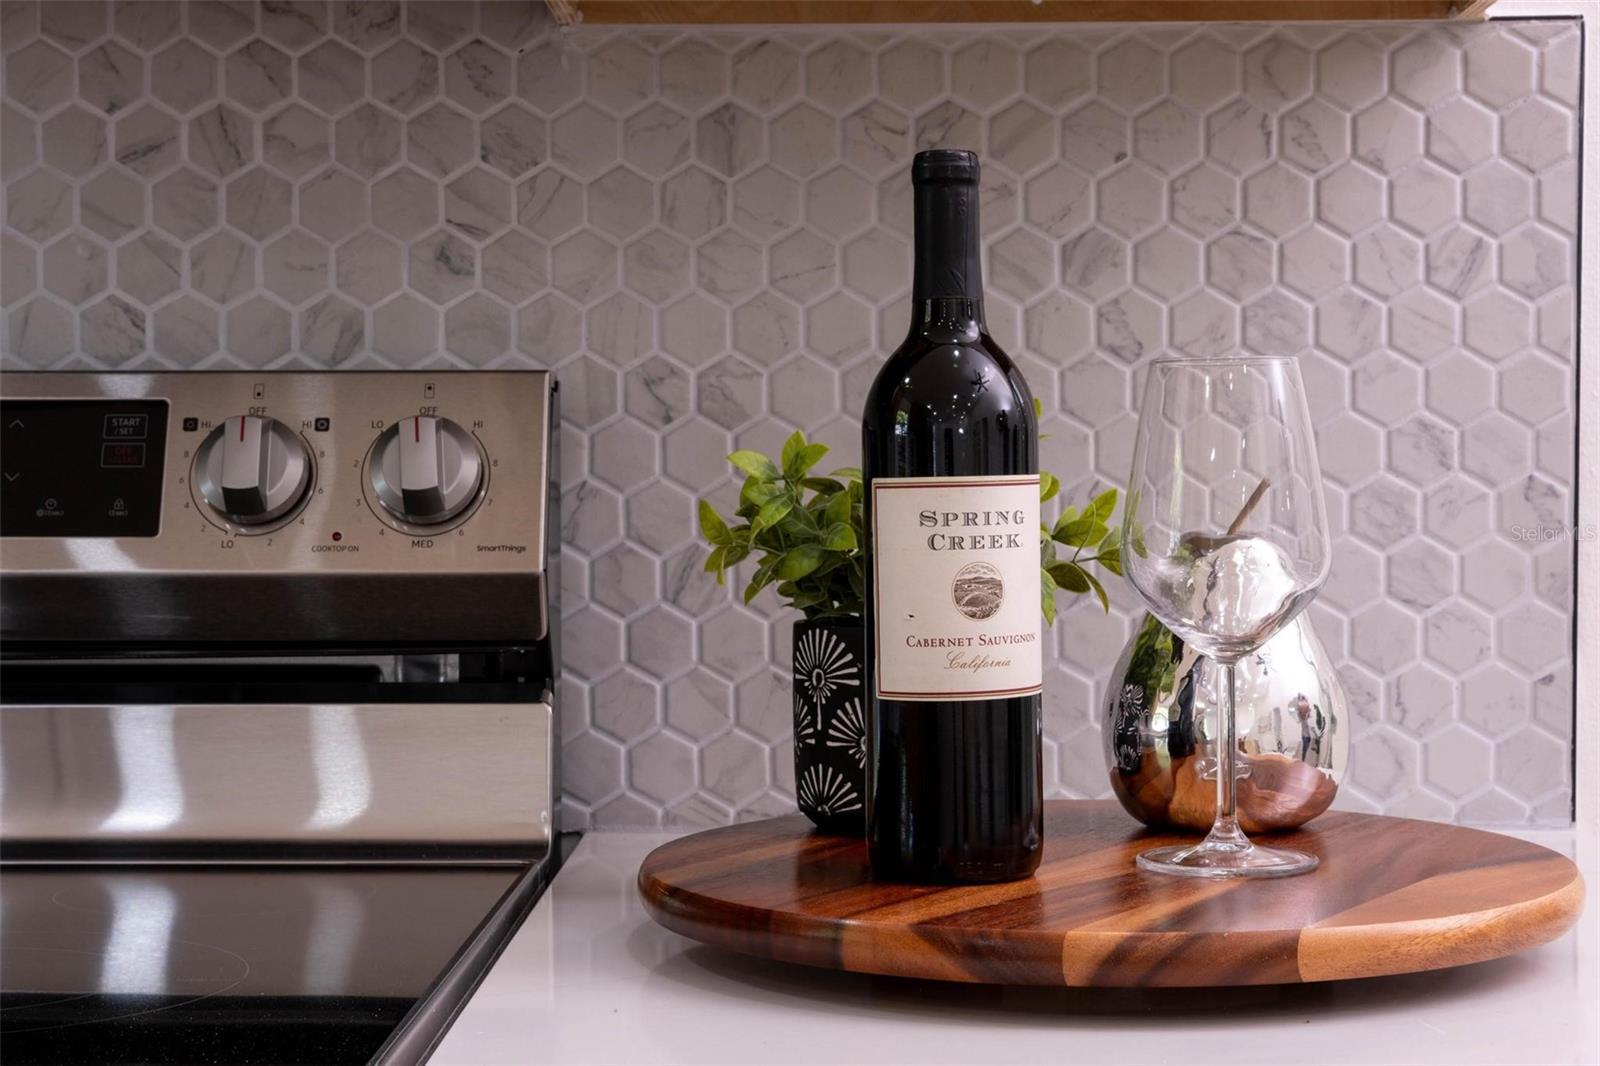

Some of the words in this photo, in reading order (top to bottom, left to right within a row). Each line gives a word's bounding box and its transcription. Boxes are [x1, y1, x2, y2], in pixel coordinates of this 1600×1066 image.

[248, 406, 268, 416] OFF
[419, 406, 439, 416] OFF
[111, 417, 141, 427] START
[302, 420, 312, 429] HI
[371, 420, 384, 429] LO
[473, 420, 483, 429] HI
[919, 509, 1025, 528] SPRING
[221, 540, 234, 549] LO
[412, 540, 434, 549] MED
[927, 532, 1022, 551] CREEK
[311, 545, 347, 553] COOKTOP
[476, 544, 527, 553] SmartThings
[906, 635, 974, 648] CABERNET
[978, 632, 1036, 647] SAUVIGNON
[944, 650, 1011, 673] California
